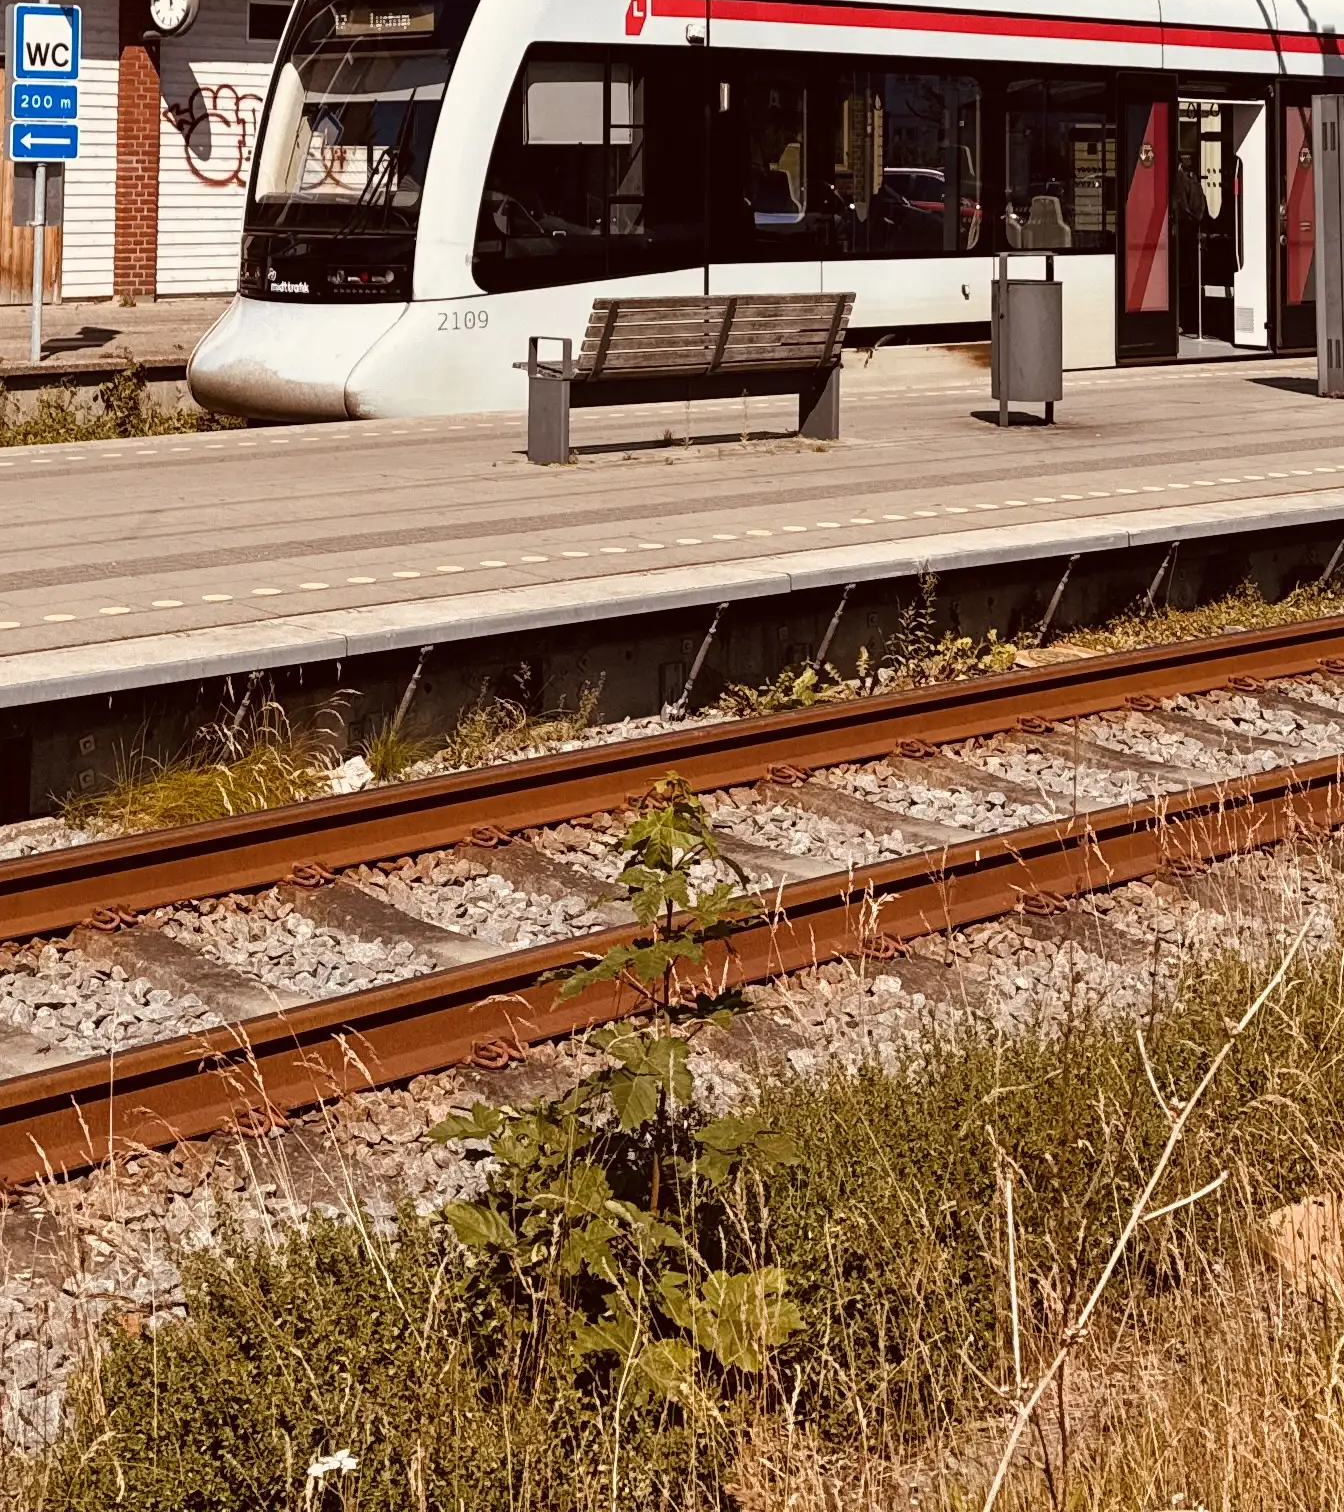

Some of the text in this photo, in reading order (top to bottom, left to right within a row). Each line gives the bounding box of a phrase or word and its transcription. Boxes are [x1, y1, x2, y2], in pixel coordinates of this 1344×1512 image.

[26, 42, 69, 67] WC
[20, 95, 71, 109] 200 m
[437, 310, 489, 331] 2109
